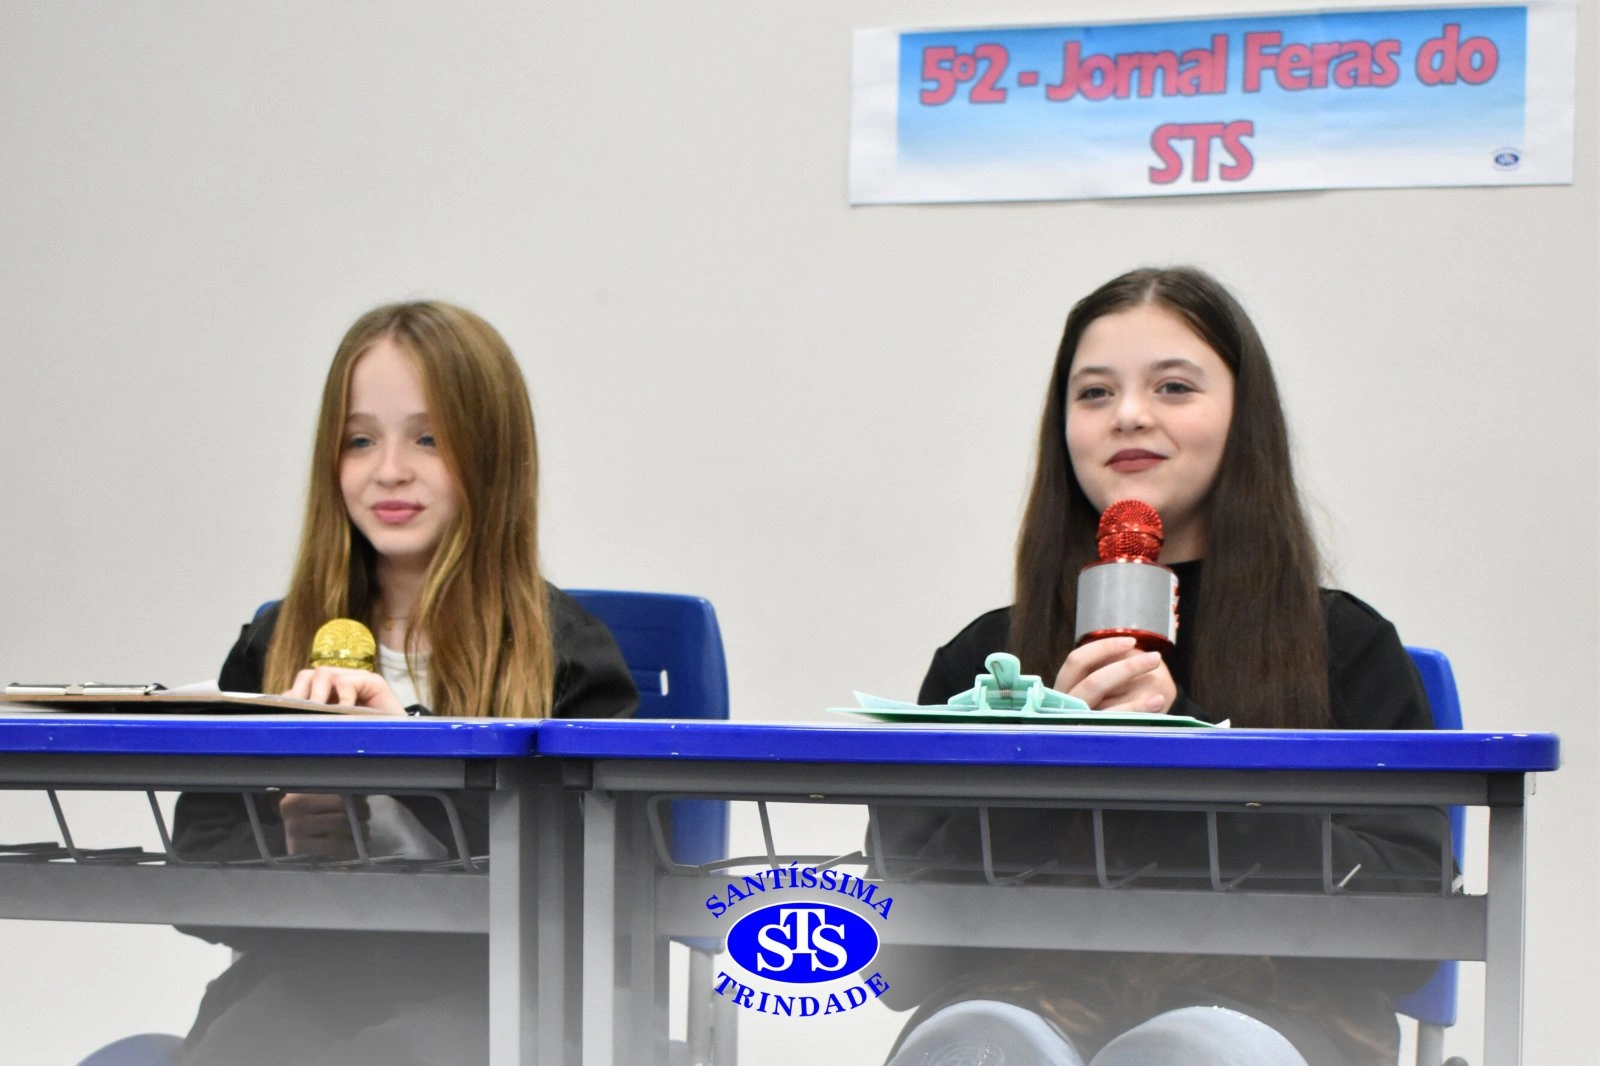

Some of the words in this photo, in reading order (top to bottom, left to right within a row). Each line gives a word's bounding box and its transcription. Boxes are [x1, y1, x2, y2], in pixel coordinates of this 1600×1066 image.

[1018, 71, 1038, 87] -
[1045, 34, 1228, 102] Jornal
[1242, 31, 1401, 92] Feras
[1415, 24, 1500, 86] do
[1148, 120, 1254, 185] STS
